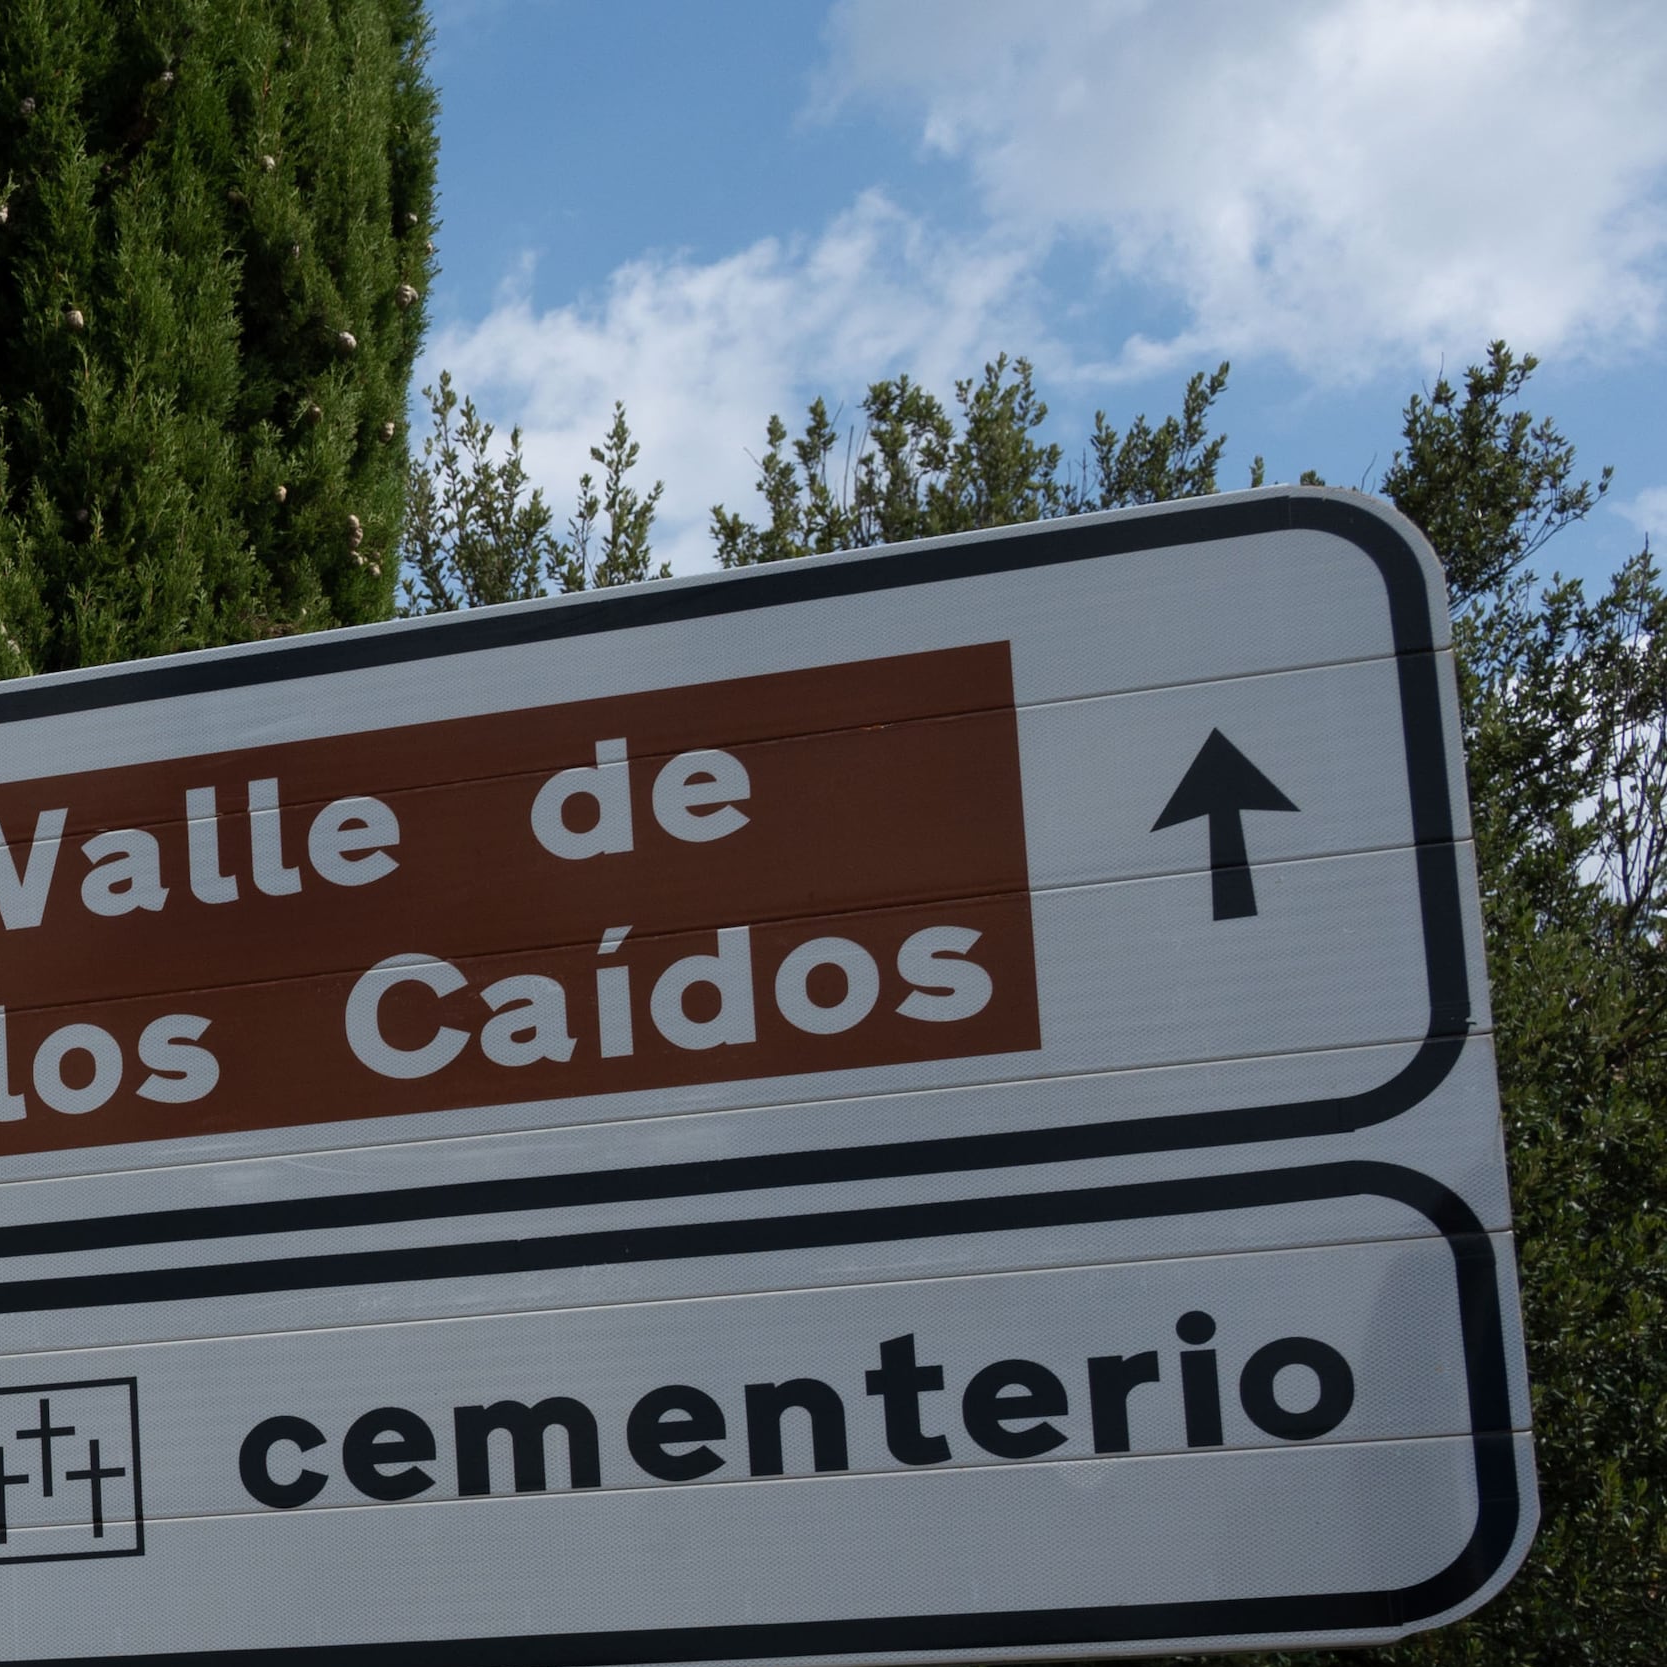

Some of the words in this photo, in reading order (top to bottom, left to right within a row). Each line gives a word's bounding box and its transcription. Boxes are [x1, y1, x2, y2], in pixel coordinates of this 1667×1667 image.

[529, 737, 752, 860] de
[345, 925, 994, 1079] Caídos
[238, 1309, 1356, 1511] cementerio
